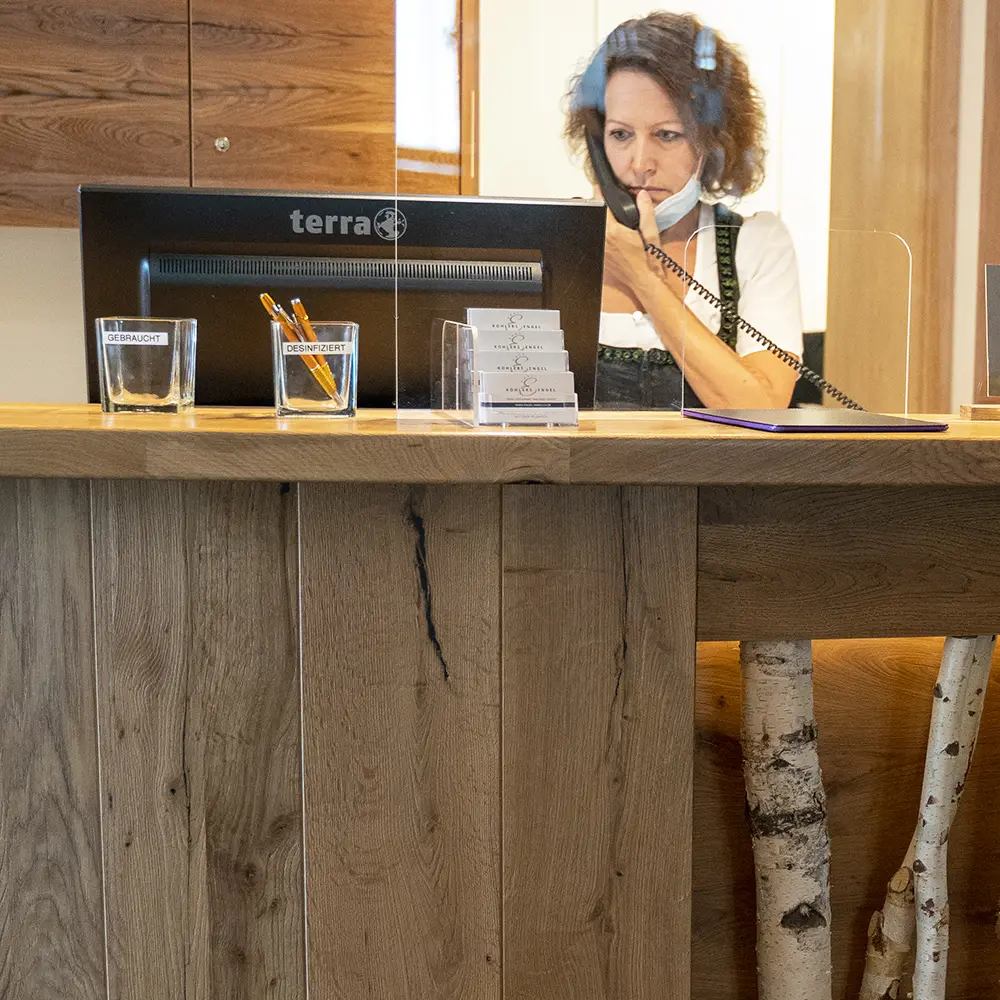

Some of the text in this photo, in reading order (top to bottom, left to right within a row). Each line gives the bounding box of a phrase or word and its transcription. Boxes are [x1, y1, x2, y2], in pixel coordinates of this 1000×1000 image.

[290, 209, 371, 235] terra
[107, 334, 161, 342] GEBRAUCHT
[286, 344, 346, 352] DESINFIZIERT
